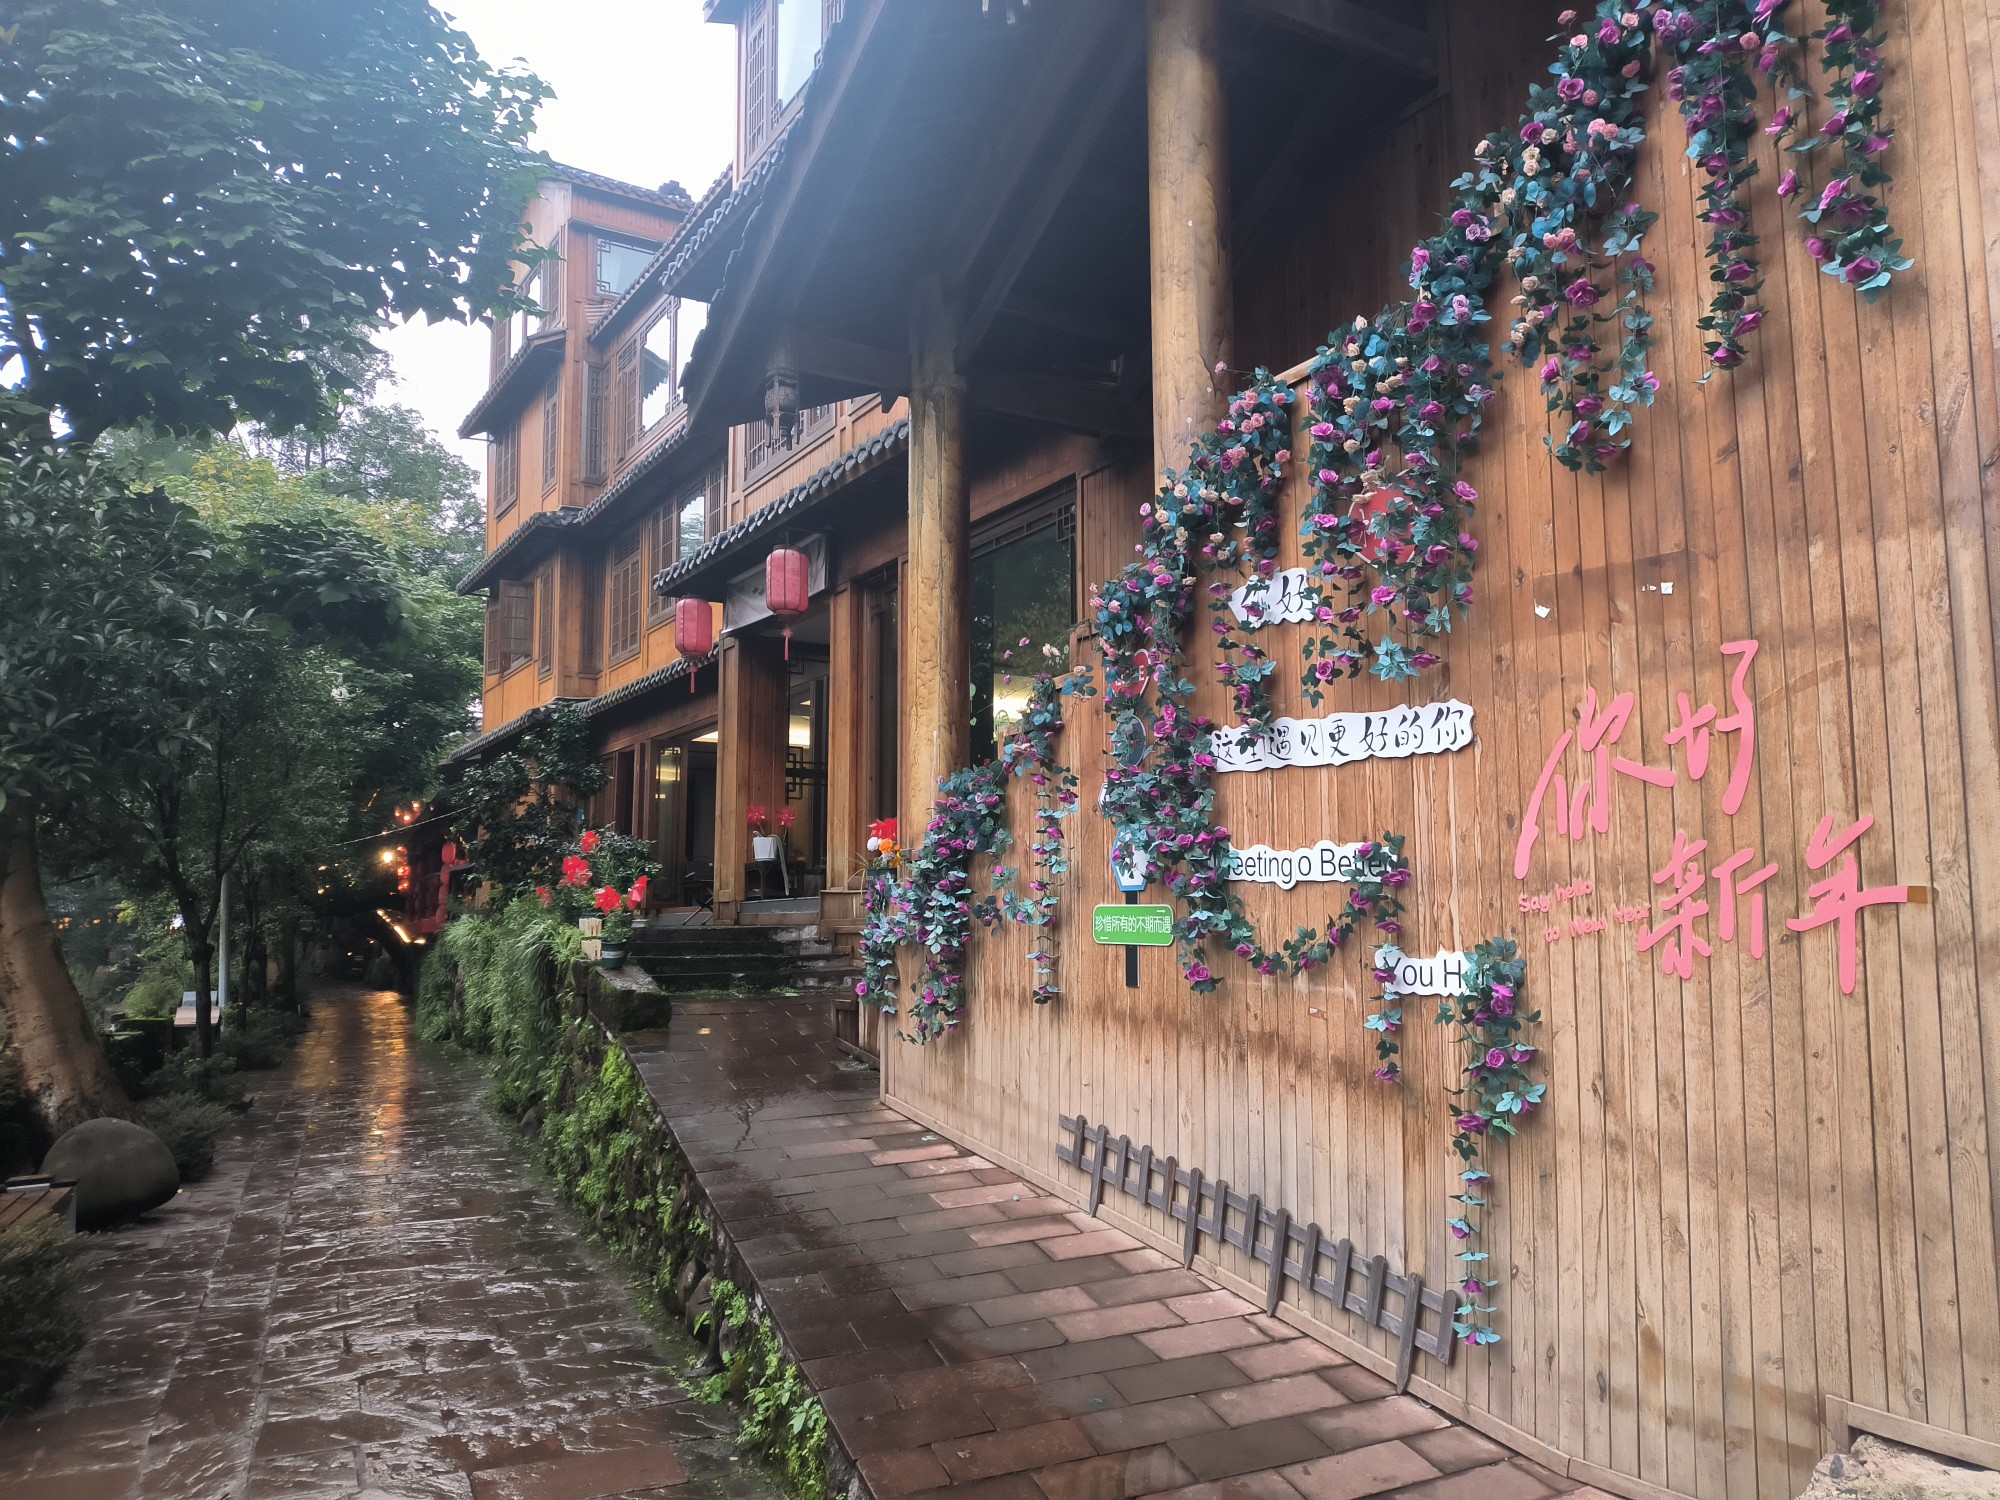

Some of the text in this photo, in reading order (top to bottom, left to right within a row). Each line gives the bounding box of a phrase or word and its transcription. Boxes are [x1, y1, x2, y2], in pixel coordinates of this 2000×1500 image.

[1514, 640, 1759, 879] 你好
[1519, 877, 1594, 912] Say hello
[1637, 815, 1938, 994] 新年
[1095, 914, 1172, 934] 珍惜所有的不期而遇
[1543, 926, 1560, 942] to
[1569, 918, 1607, 937] New
